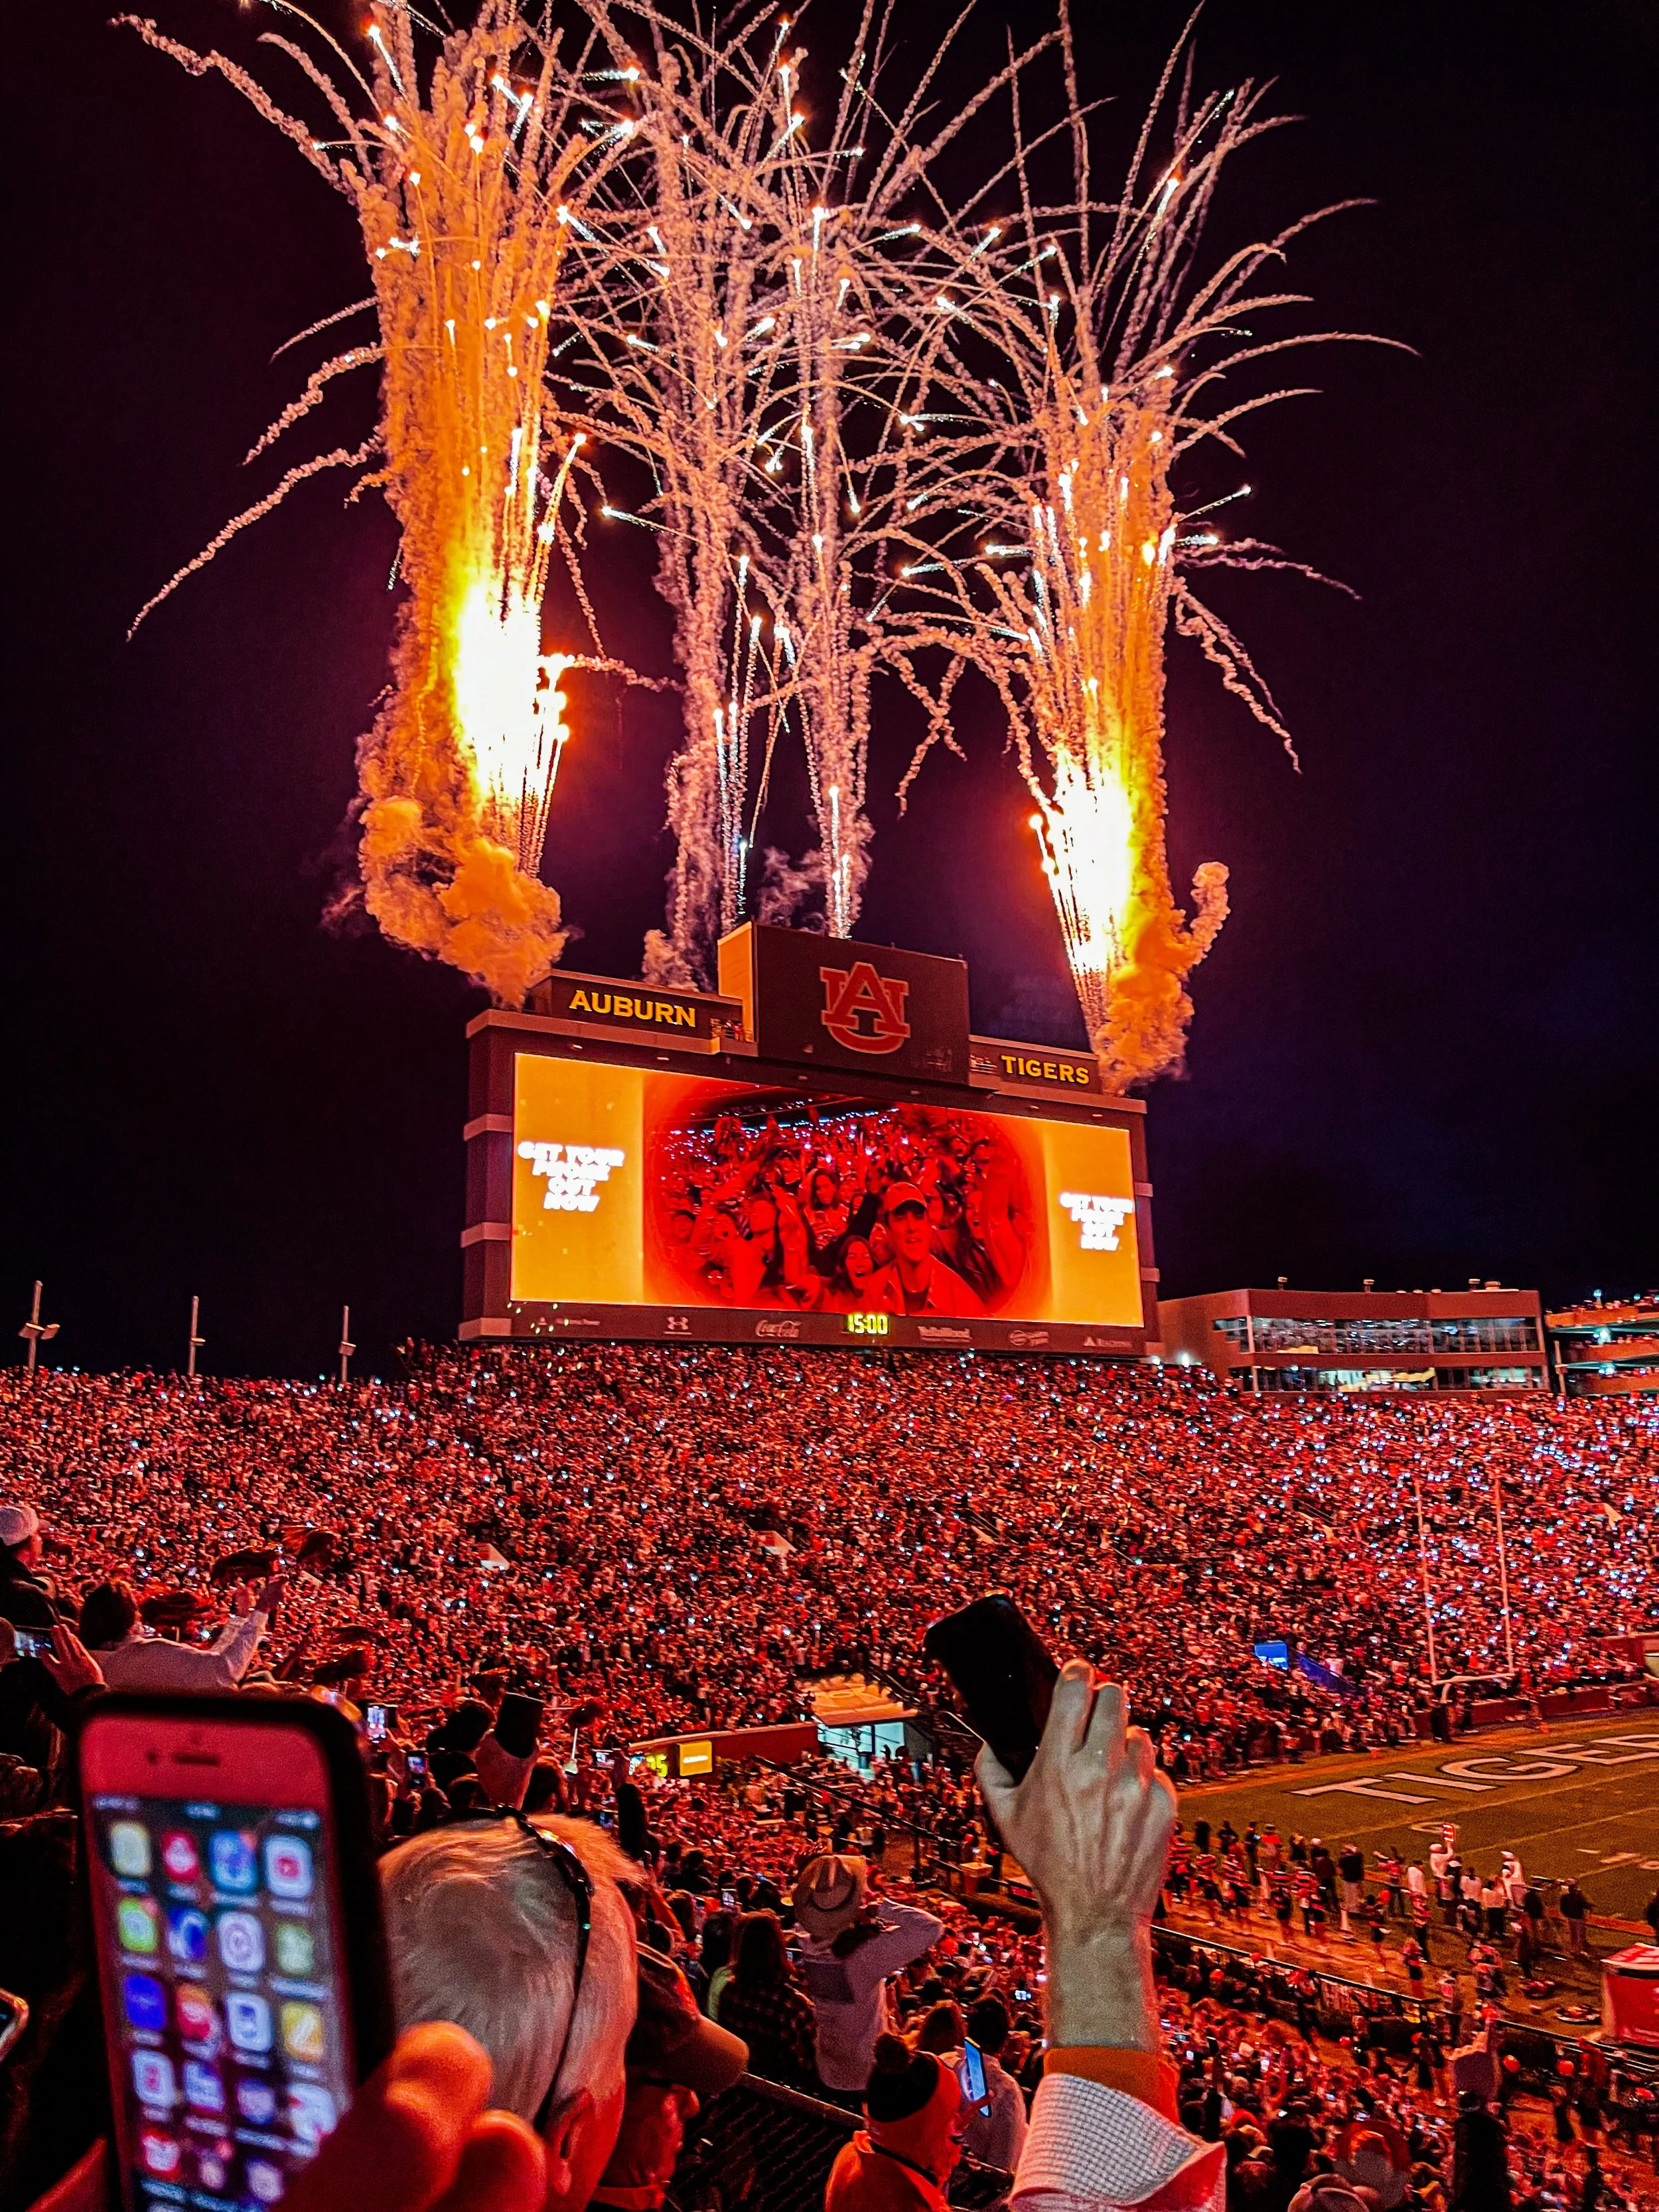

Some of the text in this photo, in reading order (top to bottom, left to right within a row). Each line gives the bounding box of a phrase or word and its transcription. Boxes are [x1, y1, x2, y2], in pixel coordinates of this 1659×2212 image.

[569, 990, 695, 1027] AUBURN
[1001, 1055, 1090, 1084] TIGERS
[847, 1313, 889, 1335] 15:00
